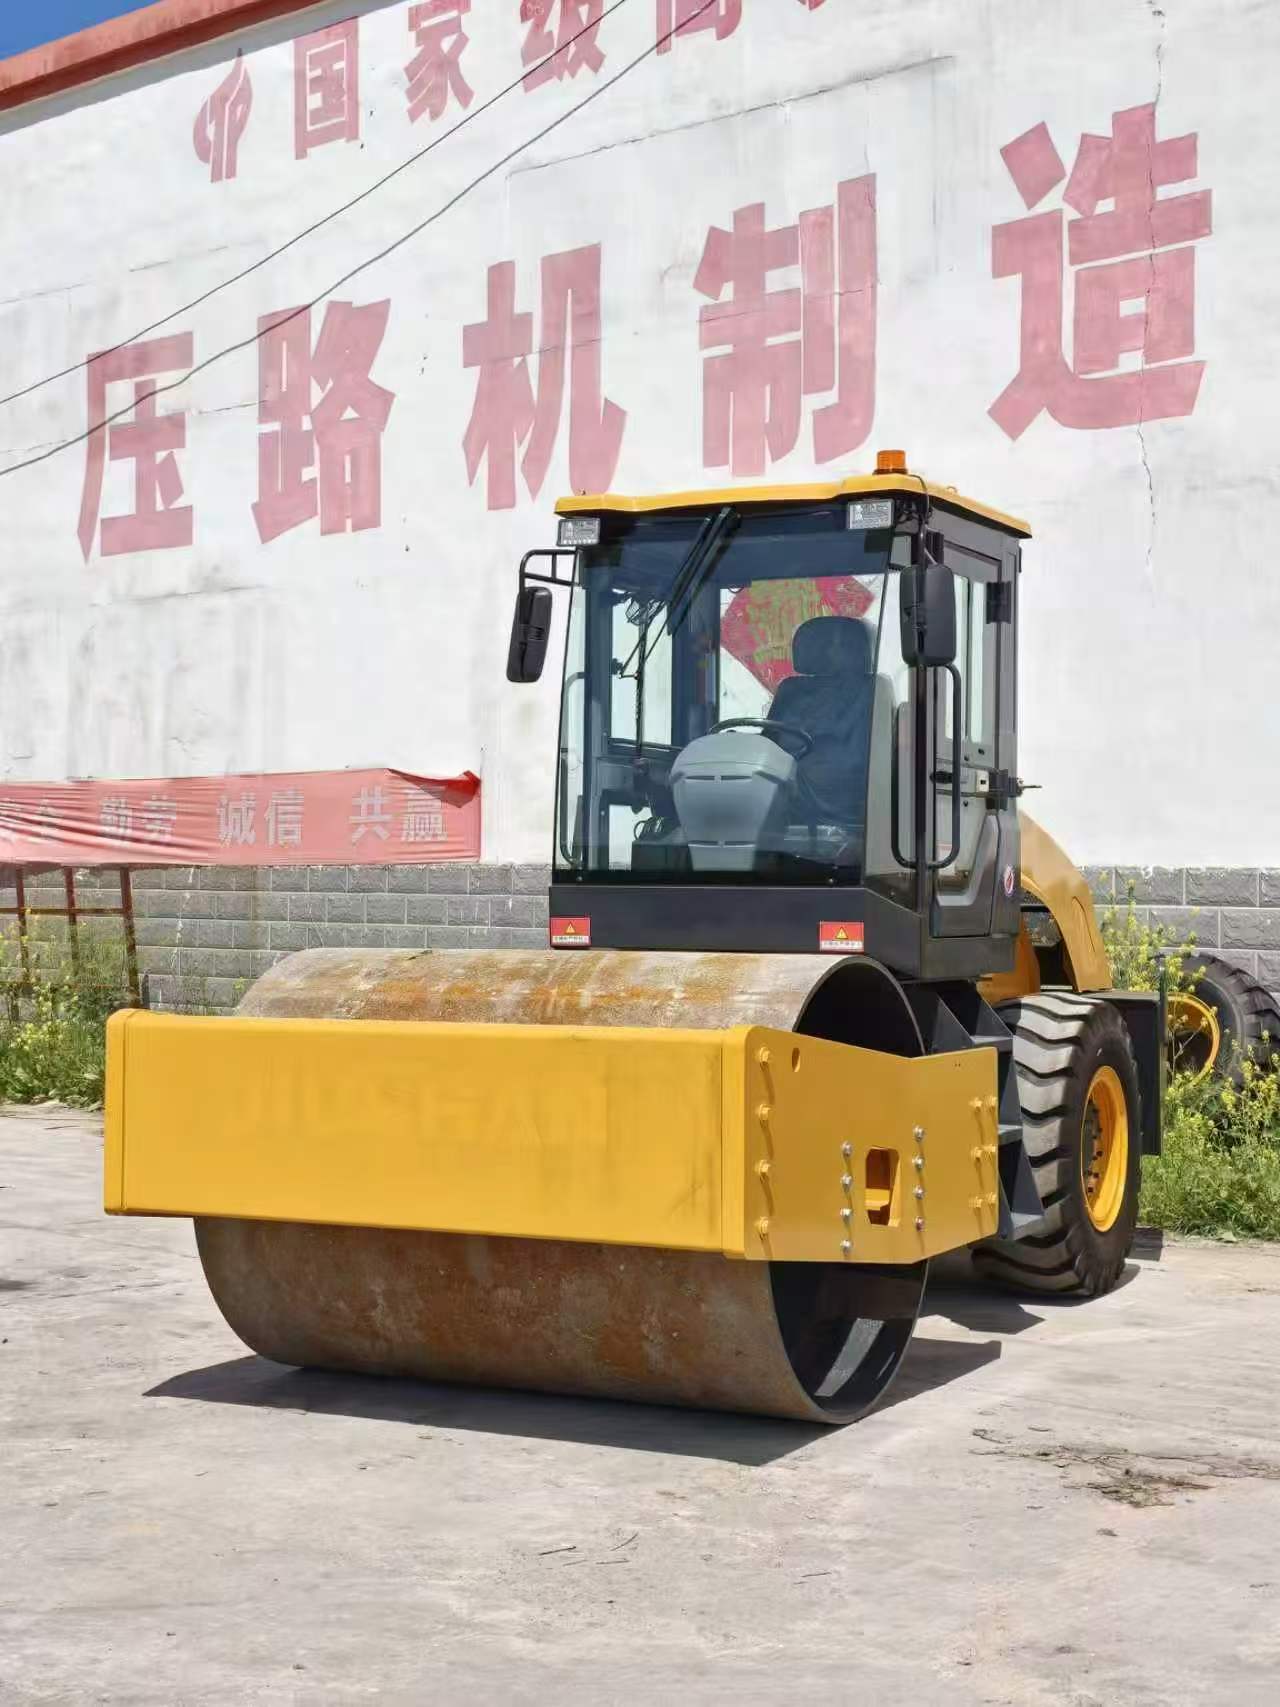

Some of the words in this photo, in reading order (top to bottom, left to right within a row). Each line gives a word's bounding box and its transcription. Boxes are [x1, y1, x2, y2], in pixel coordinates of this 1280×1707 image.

[77, 102, 1213, 565] 压路机制造
[216, 790, 304, 847] 诚信
